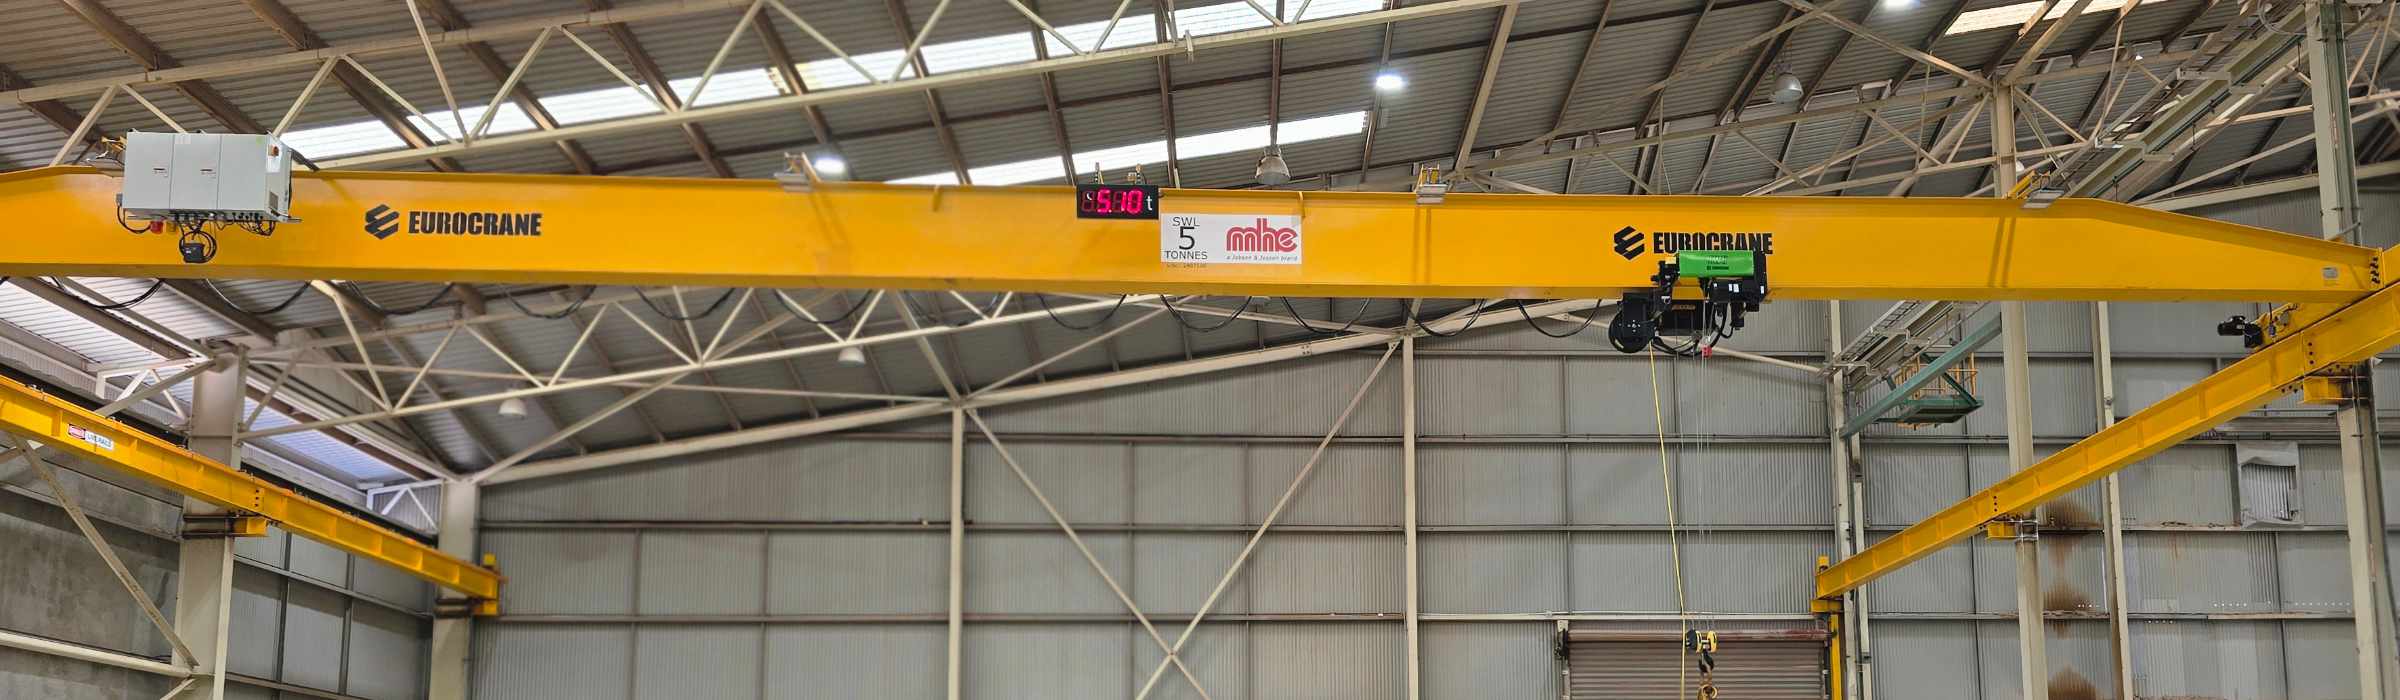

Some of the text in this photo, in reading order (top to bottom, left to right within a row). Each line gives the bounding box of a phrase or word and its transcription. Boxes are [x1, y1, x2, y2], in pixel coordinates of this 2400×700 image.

[1096, 189, 1153, 215] 5.10 t
[408, 210, 542, 237] EUROCRANE
[1172, 216, 1201, 227] SWL
[1178, 226, 1196, 250] 5
[1225, 217, 1298, 253] mhe
[1653, 231, 1773, 254] EUROCRANE
[1164, 250, 1208, 260] TONNES
